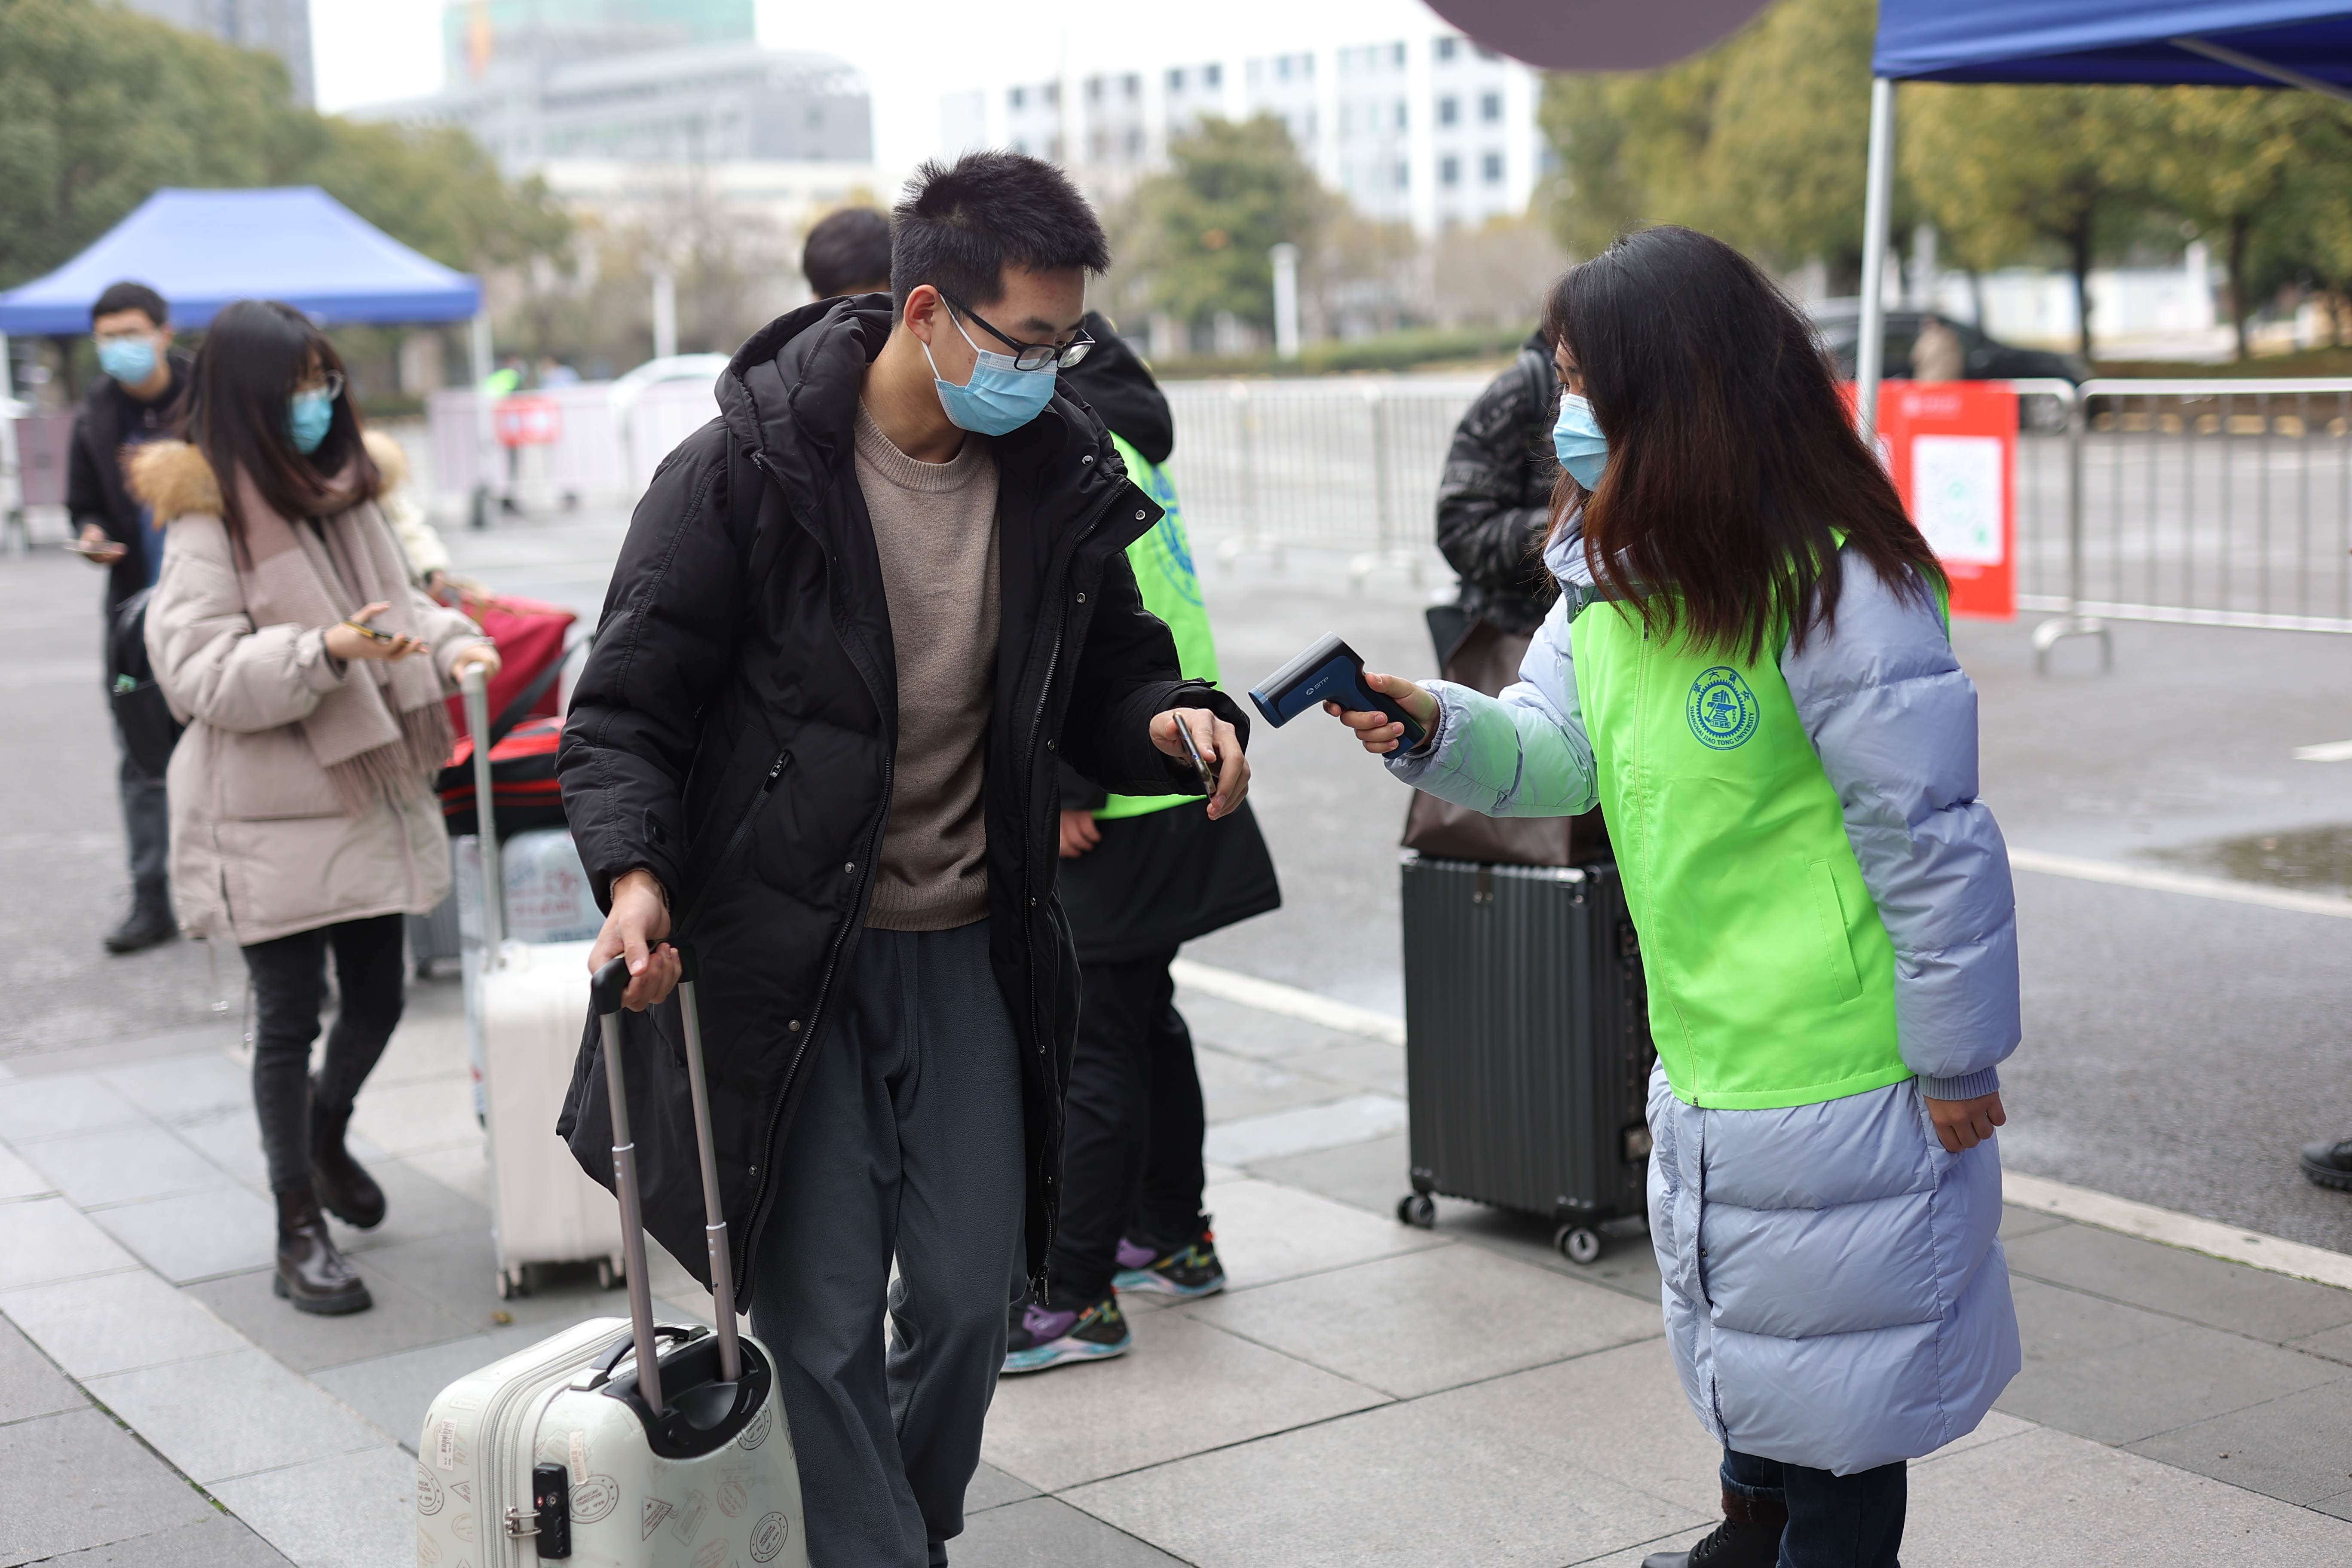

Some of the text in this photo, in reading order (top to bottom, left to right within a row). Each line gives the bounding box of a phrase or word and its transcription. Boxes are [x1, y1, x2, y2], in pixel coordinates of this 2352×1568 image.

[1314, 677, 1329, 689] SITP
[1690, 705, 1704, 737] SHANGHAI
[1703, 734, 1716, 745] JIAO
[1735, 712, 1755, 742] UNIVERSITY
